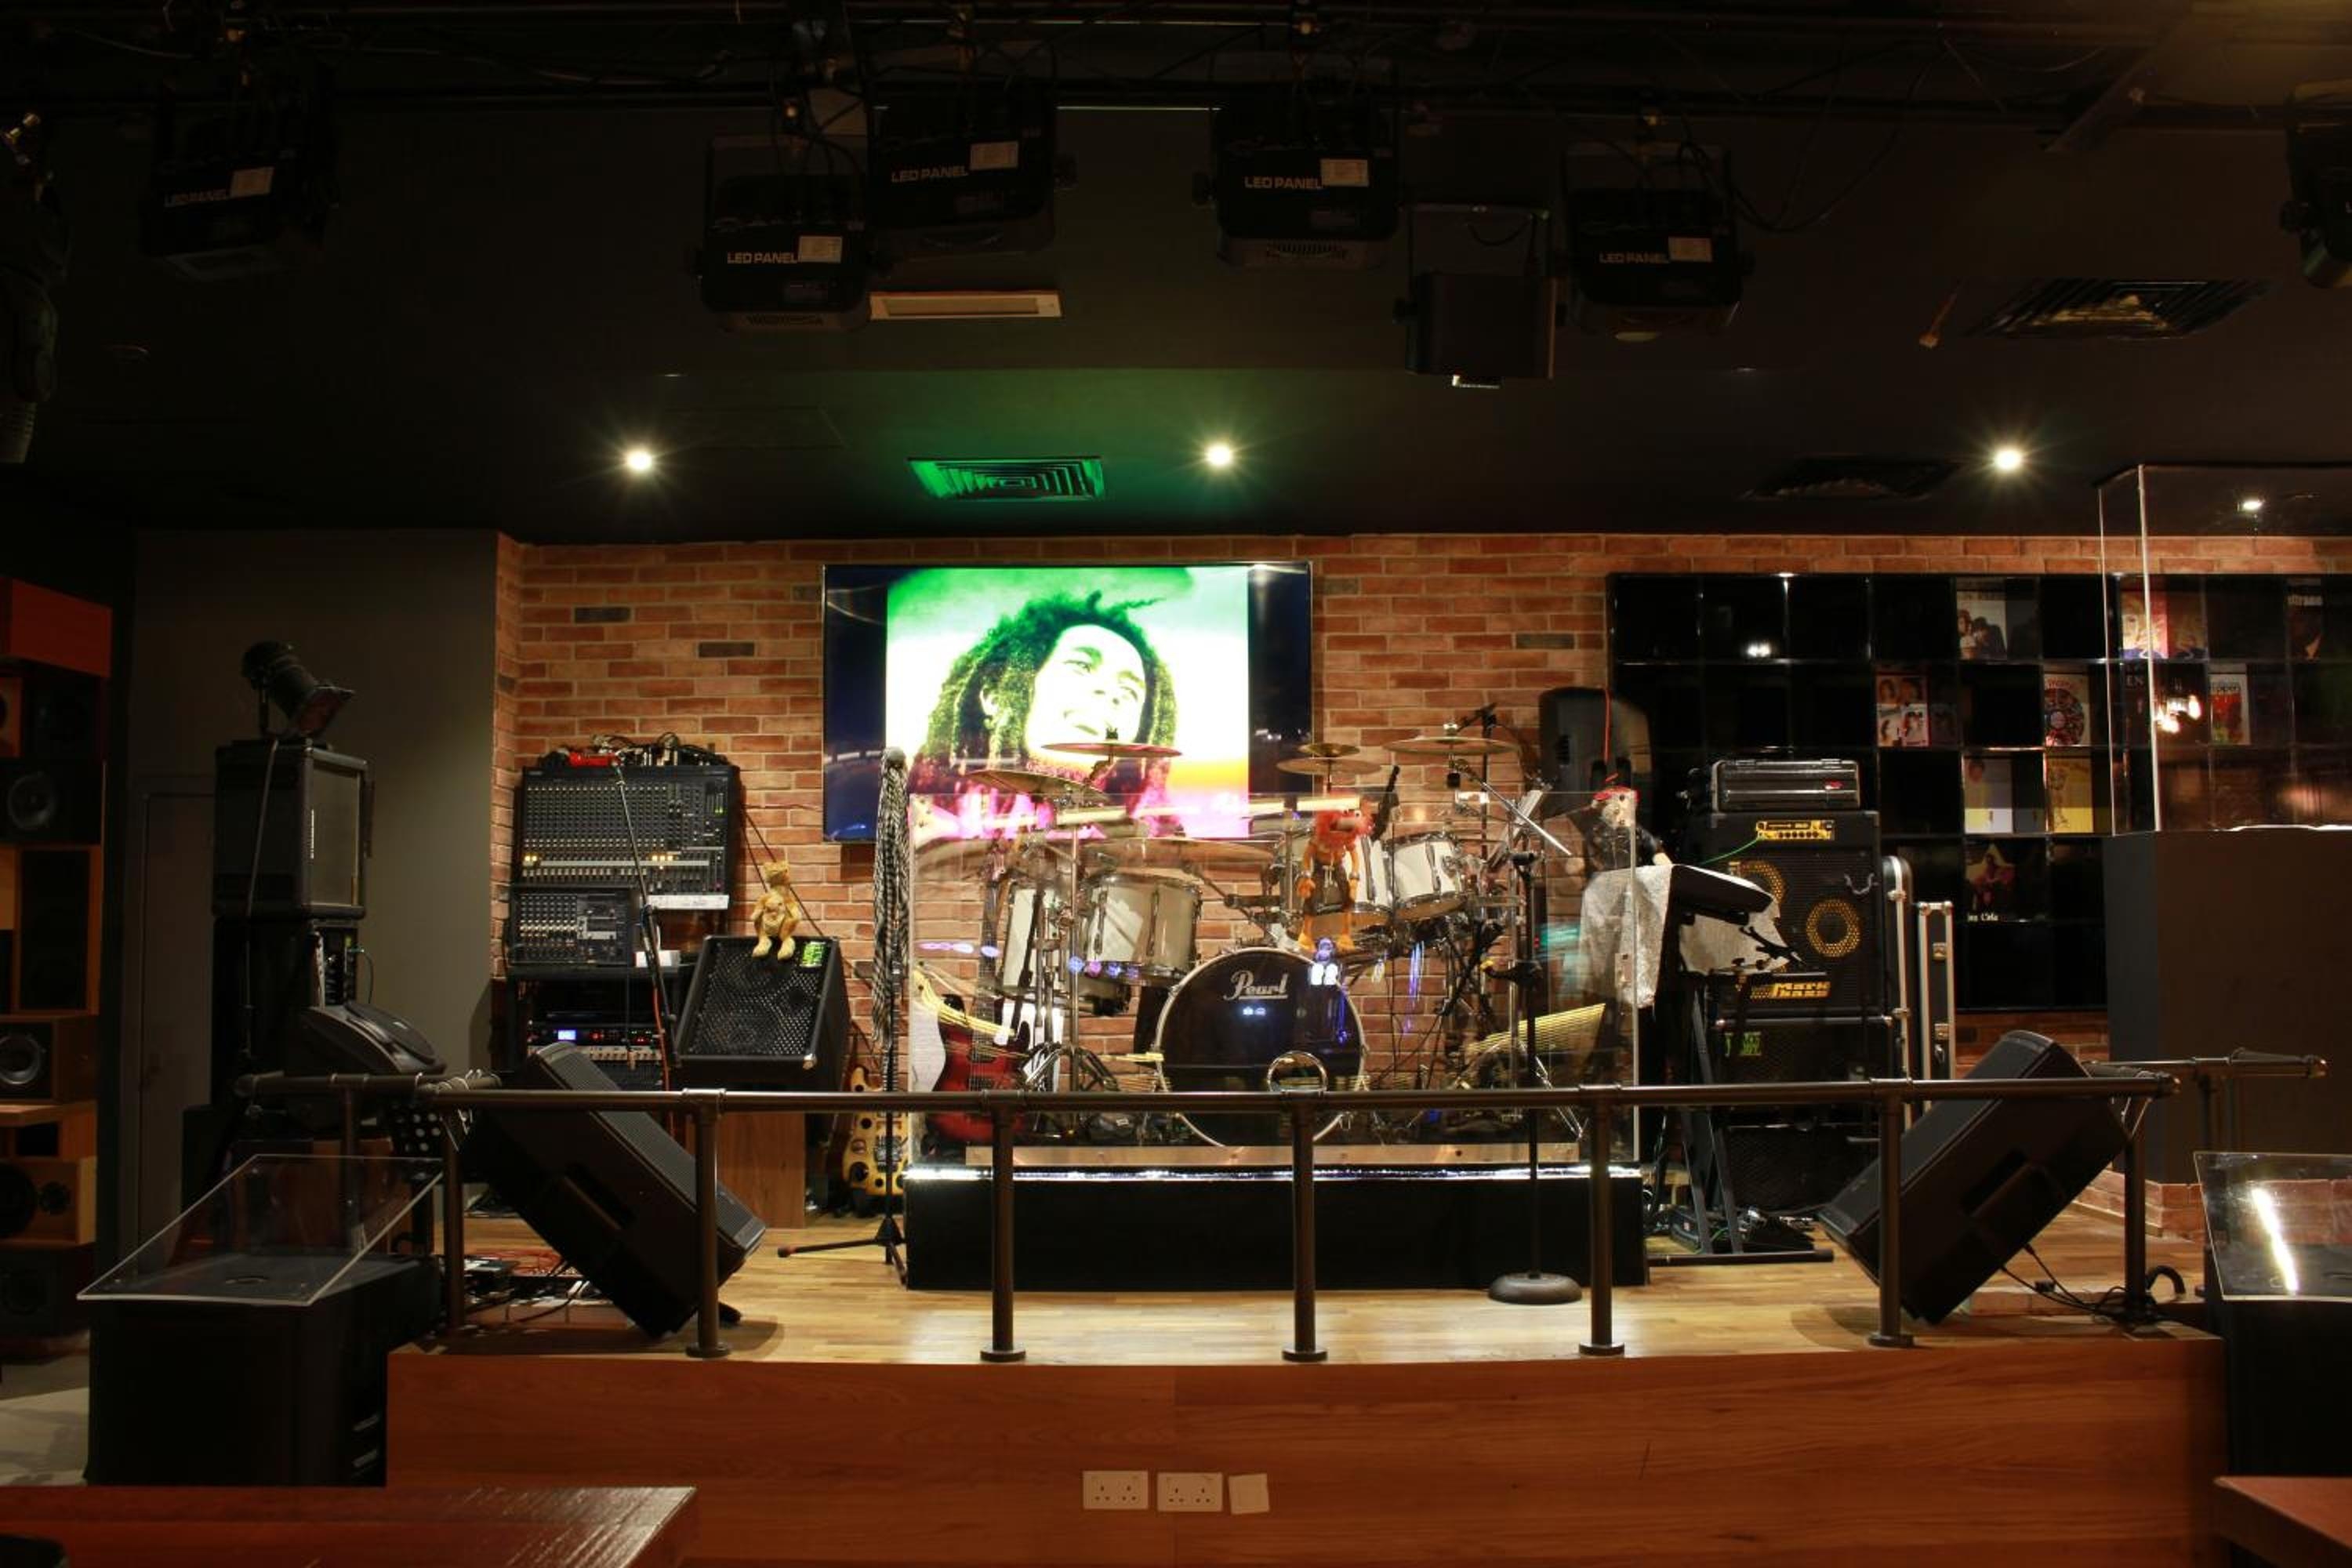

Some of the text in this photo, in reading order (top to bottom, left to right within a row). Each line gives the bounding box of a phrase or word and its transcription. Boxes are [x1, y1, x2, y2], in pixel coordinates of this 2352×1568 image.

[891, 165, 968, 183] LED PANEL
[1243, 176, 1323, 189] LED PANEL
[727, 251, 798, 264] LED PANEL
[1599, 252, 1624, 264] LED
[1223, 969, 1289, 1001] Pearl
